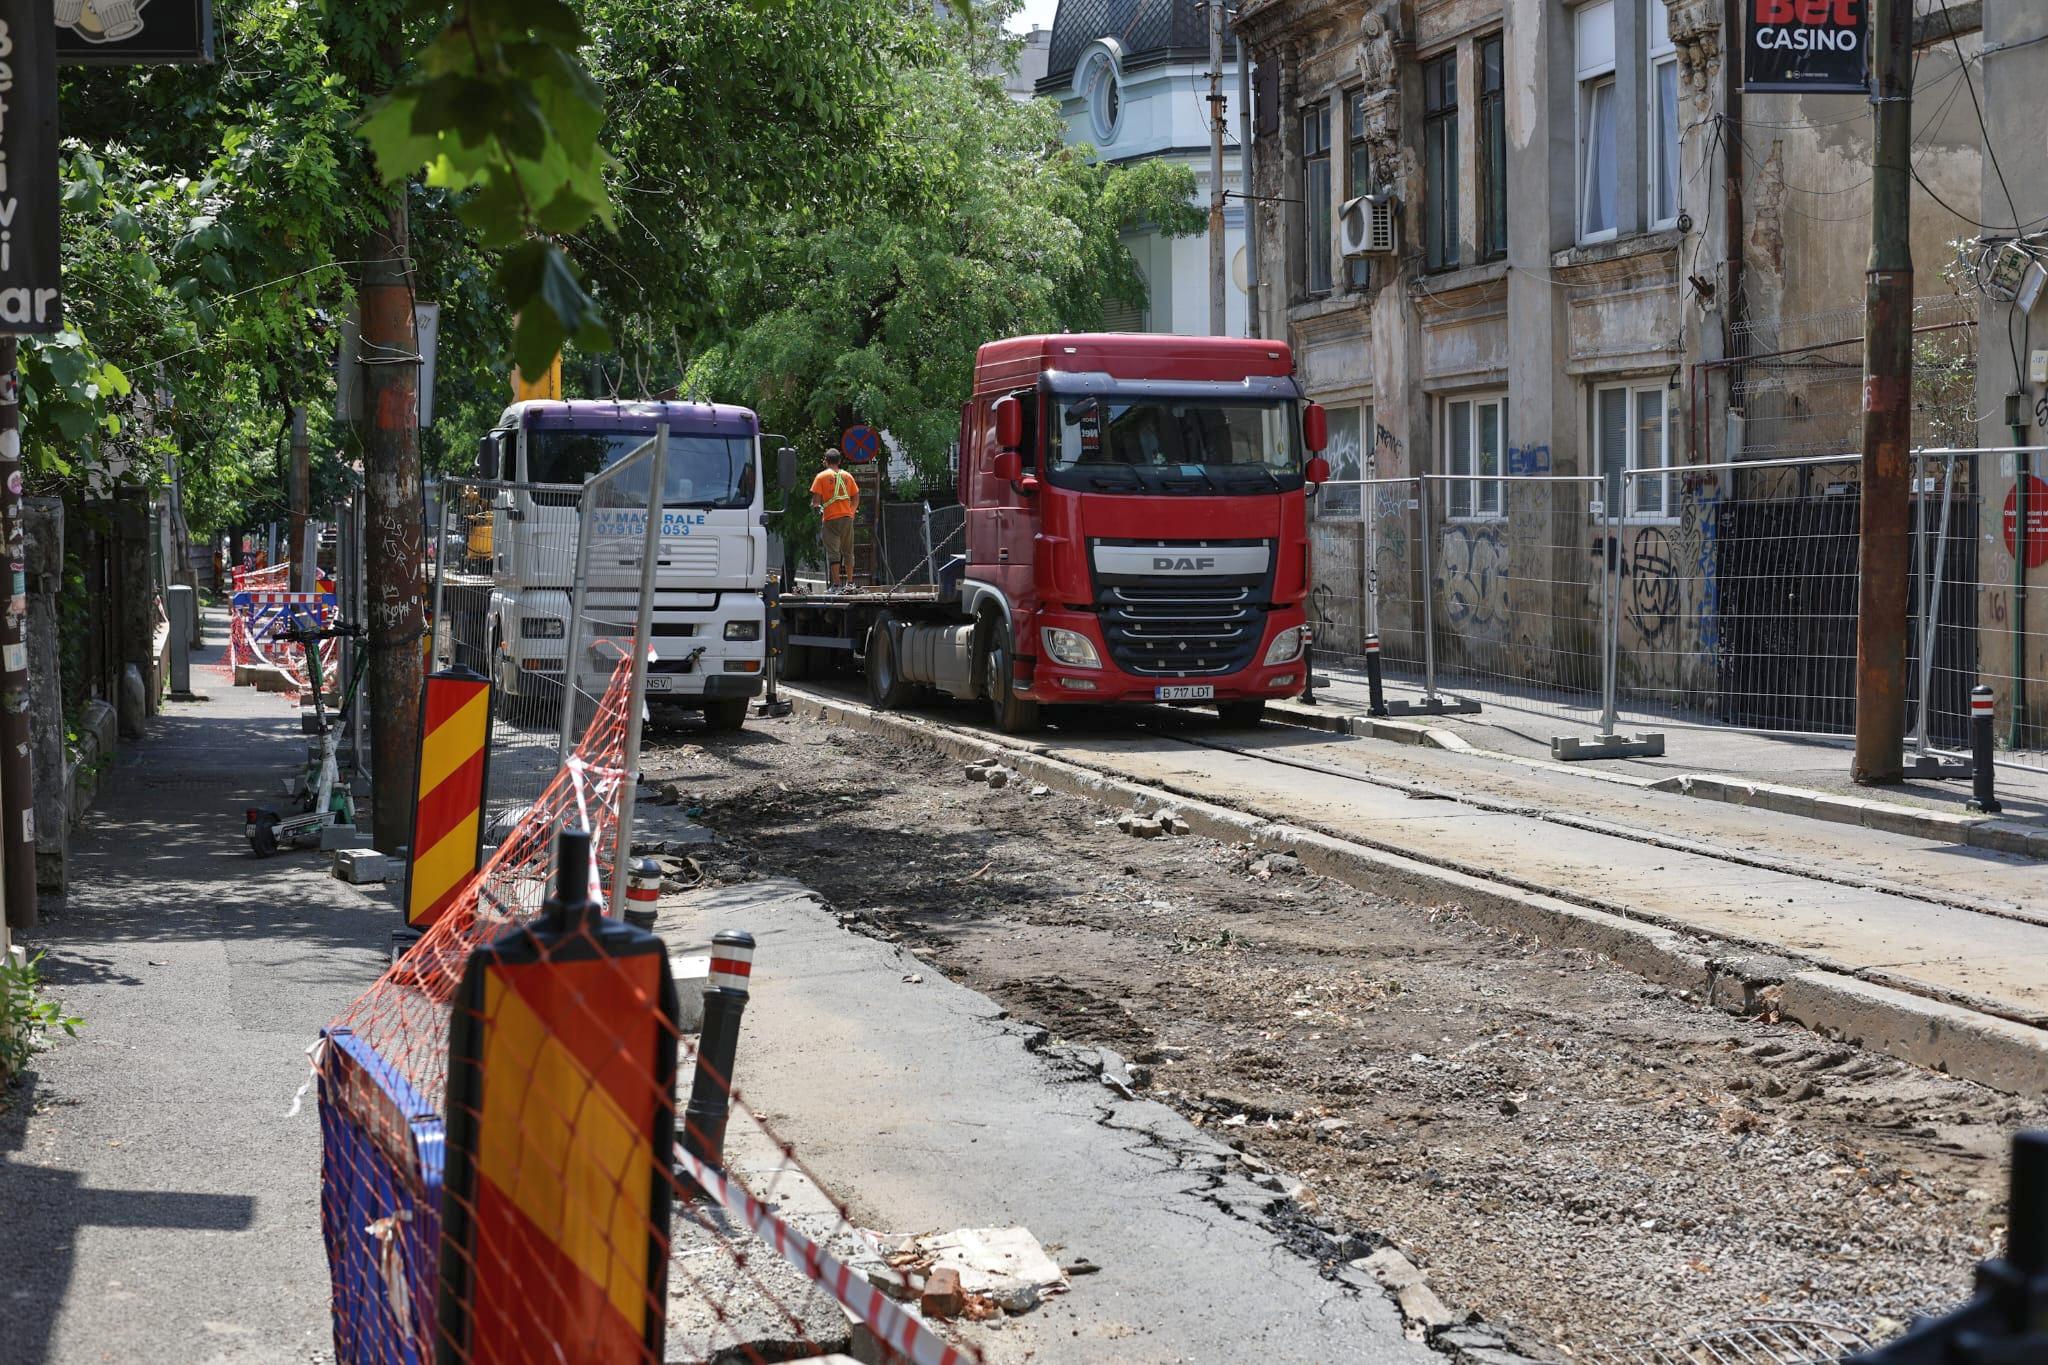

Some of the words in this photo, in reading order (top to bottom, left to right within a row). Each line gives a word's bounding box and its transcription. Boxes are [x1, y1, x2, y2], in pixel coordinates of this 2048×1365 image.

[1756, 27, 1857, 51] CASINO
[616, 513, 705, 525] MACRALE
[598, 523, 690, 536] 07915053
[1153, 557, 1215, 570] DAF
[646, 679, 667, 689] NSV
[1163, 688, 1171, 699] B
[1174, 687, 1189, 698] 717
[1191, 686, 1211, 698] LDT
